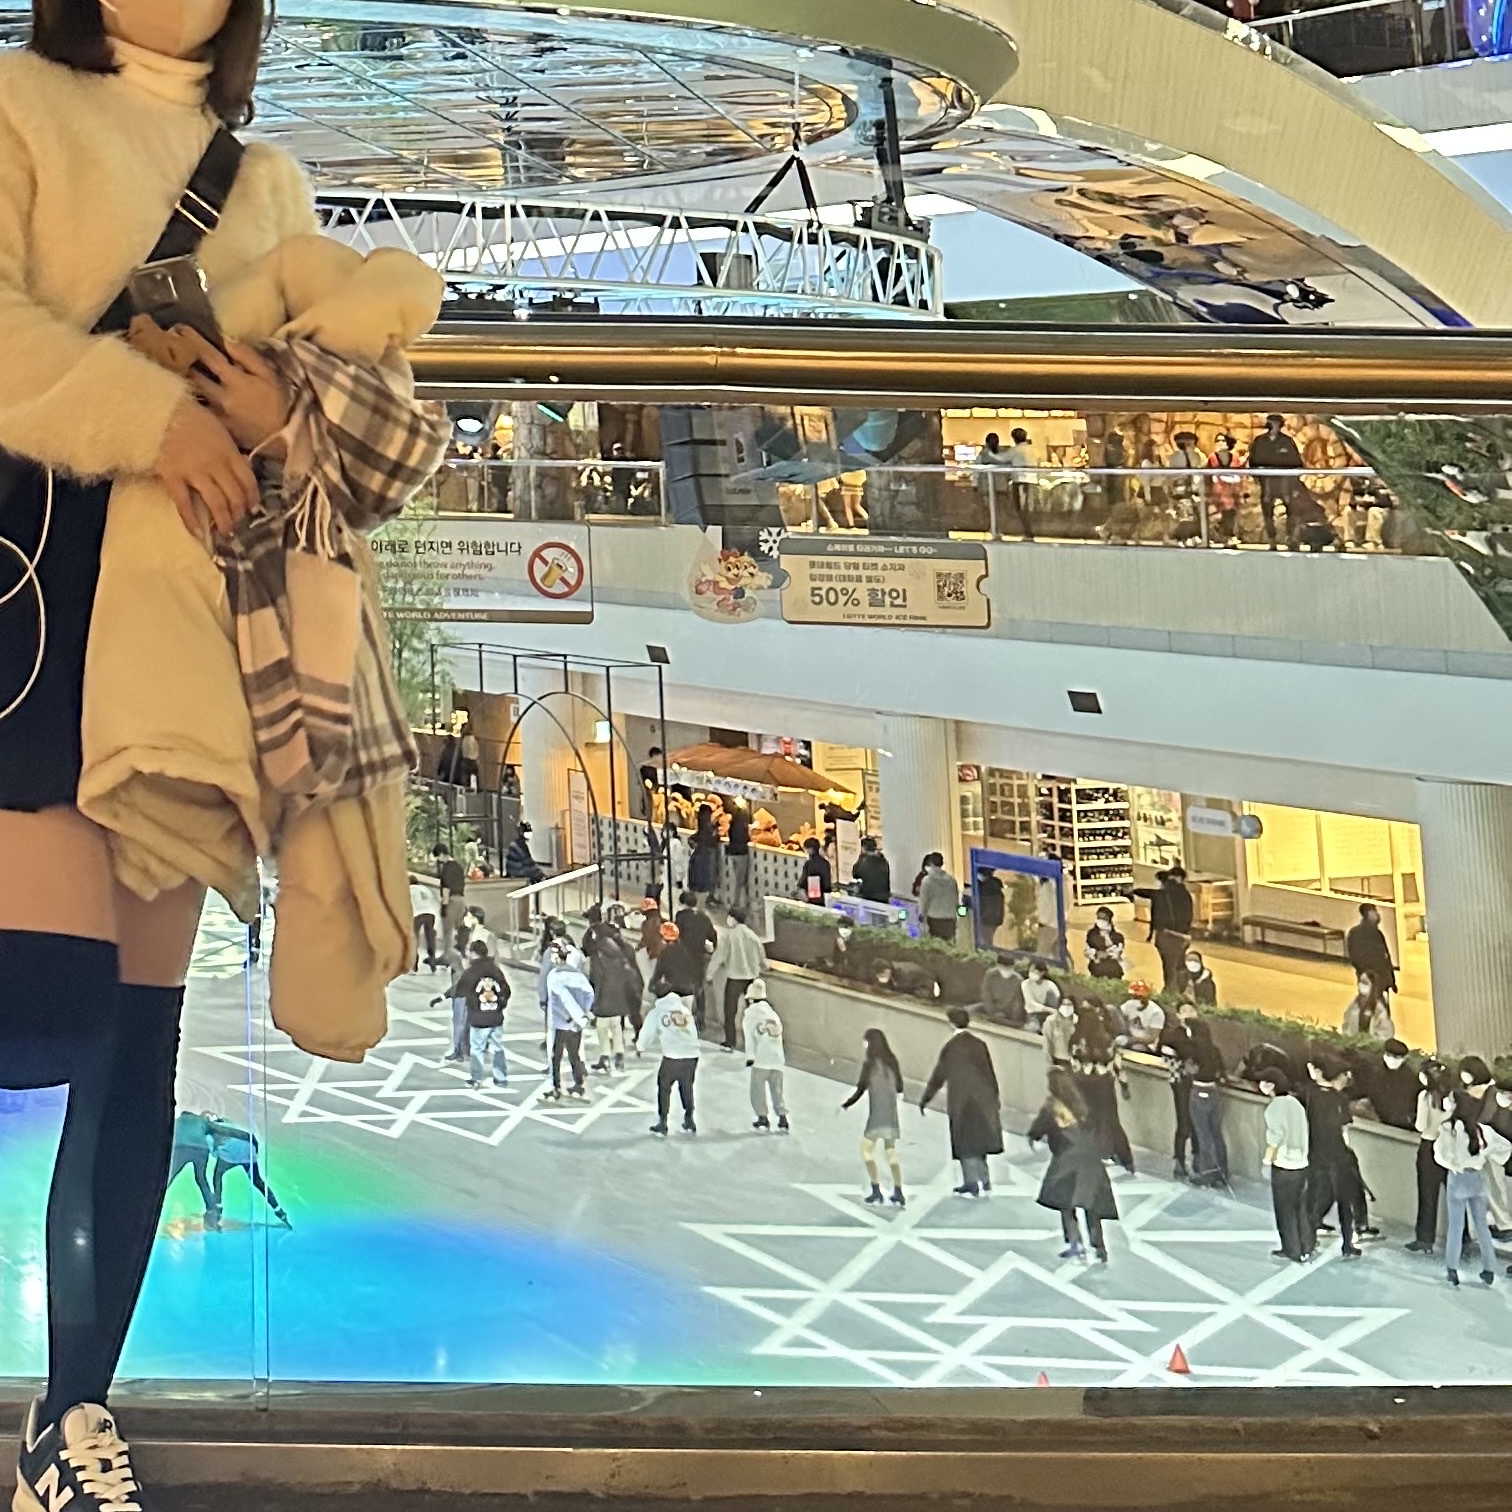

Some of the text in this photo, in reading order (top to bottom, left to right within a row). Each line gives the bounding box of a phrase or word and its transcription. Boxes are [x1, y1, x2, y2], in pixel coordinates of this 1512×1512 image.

[371, 539, 522, 556] 아래로 던지면 위험합니다
[809, 586, 908, 608] 50% 할인
[395, 610, 431, 619] WORLD
[433, 611, 489, 620] ADVENTURE
